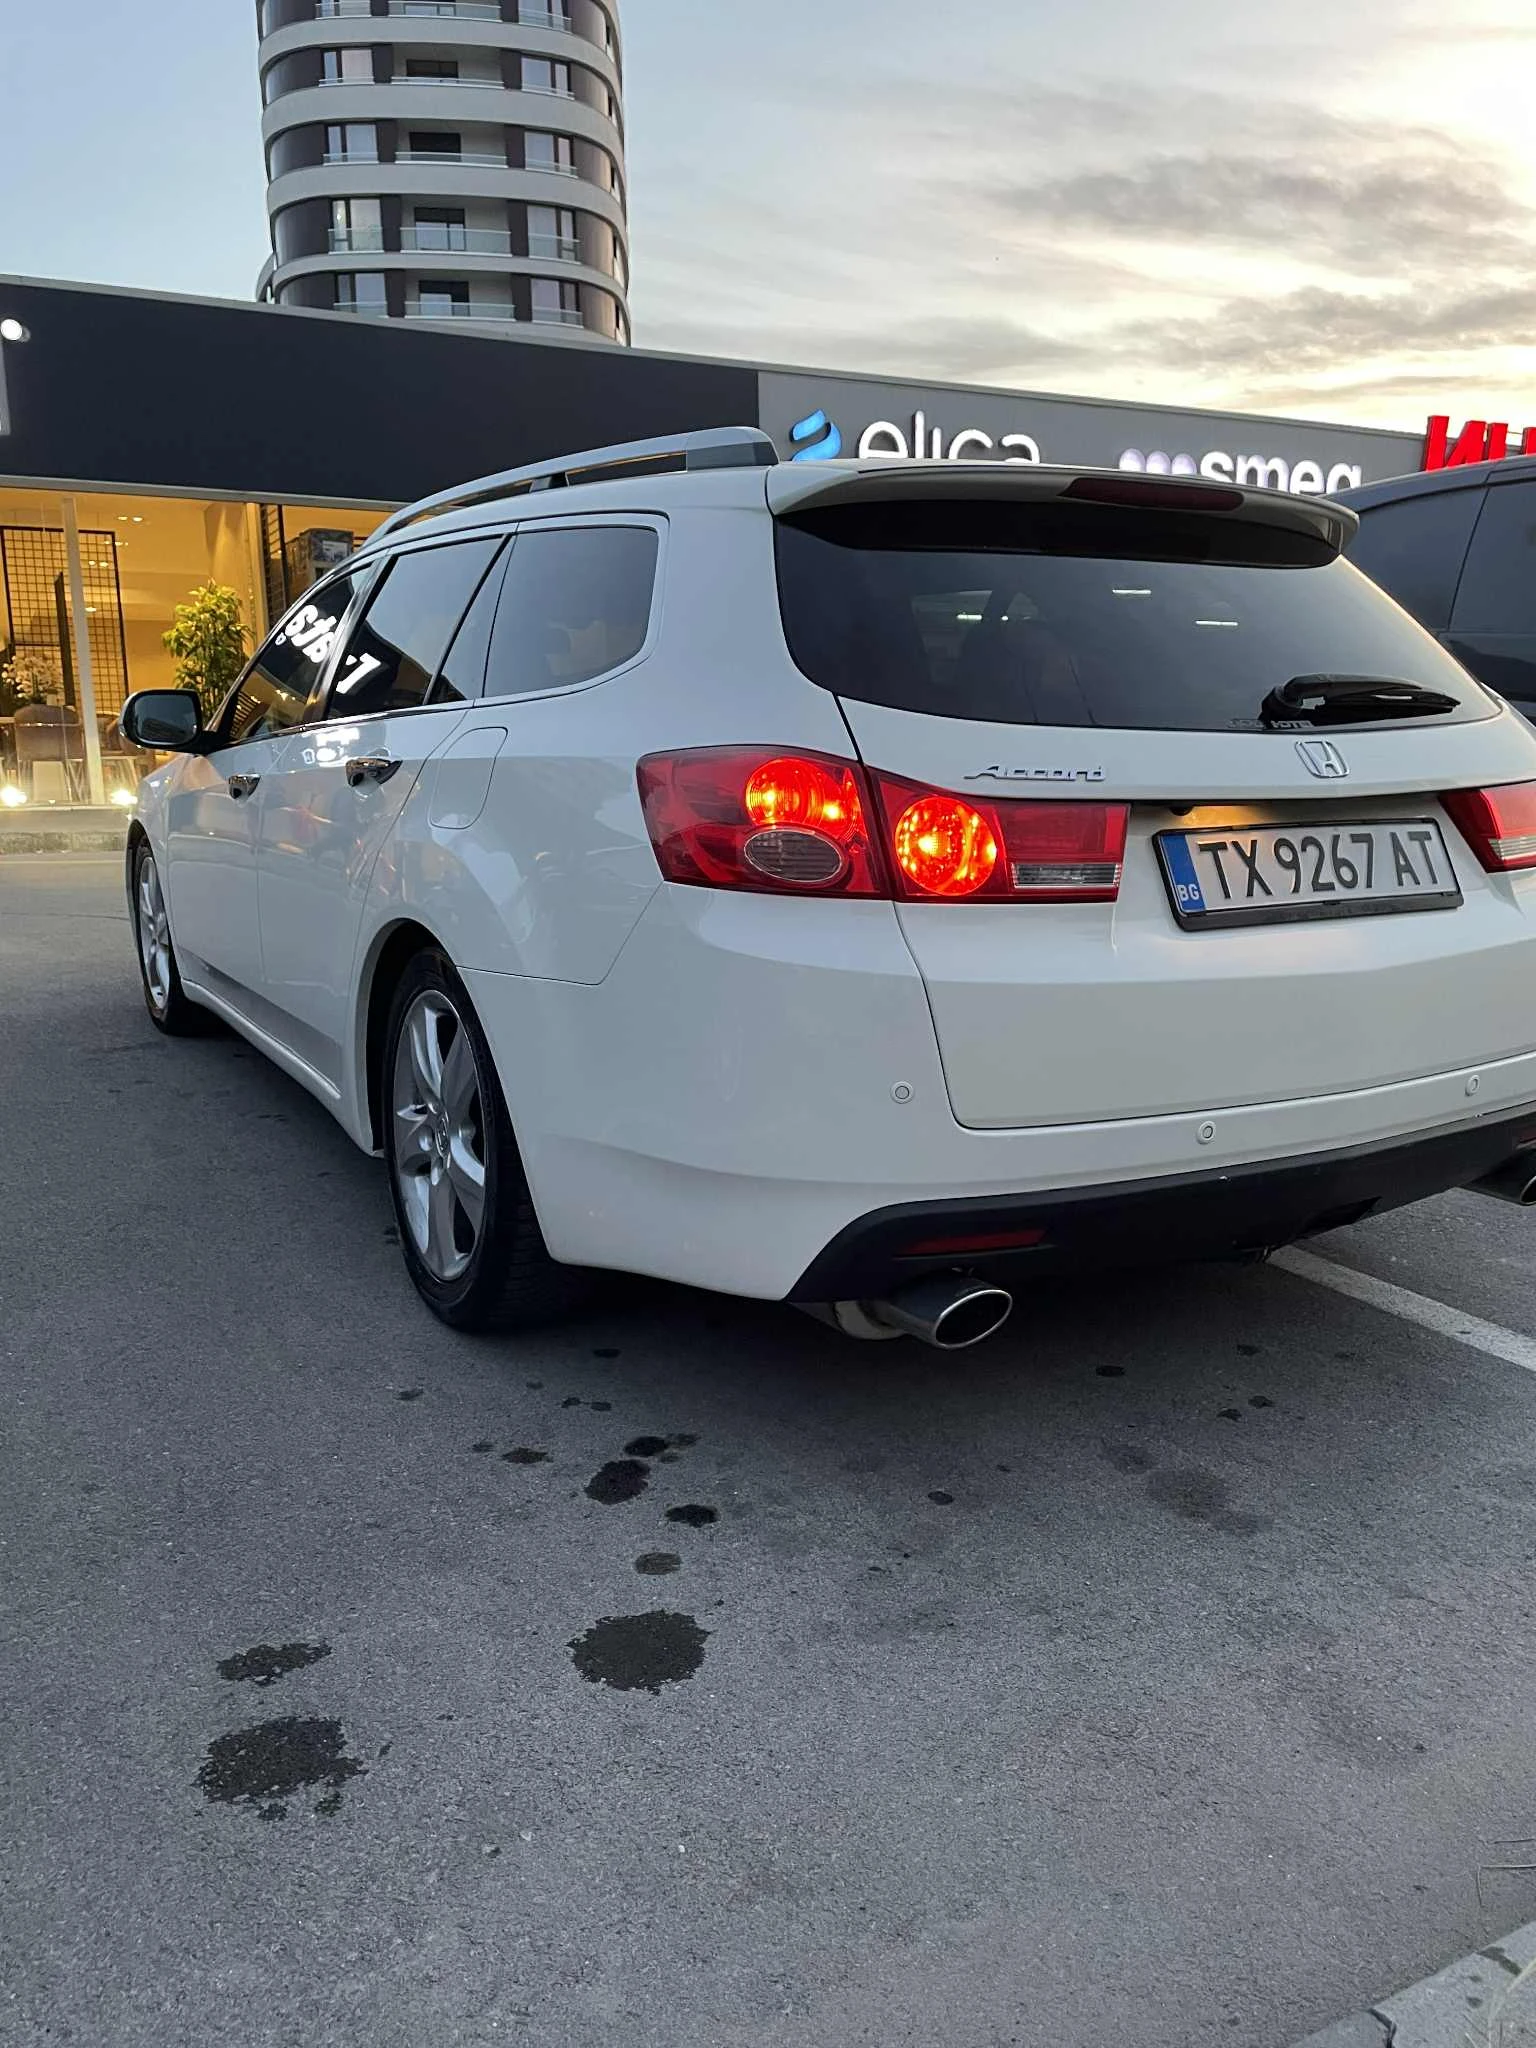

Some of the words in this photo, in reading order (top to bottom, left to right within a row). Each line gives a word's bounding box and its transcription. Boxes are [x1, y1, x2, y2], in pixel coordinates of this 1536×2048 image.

[963, 764, 1106, 782] Accord
[1197, 839, 1273, 899] TX
[1273, 832, 1375, 894] 9267
[1389, 830, 1438, 887] AT
[1176, 883, 1200, 902] BG
